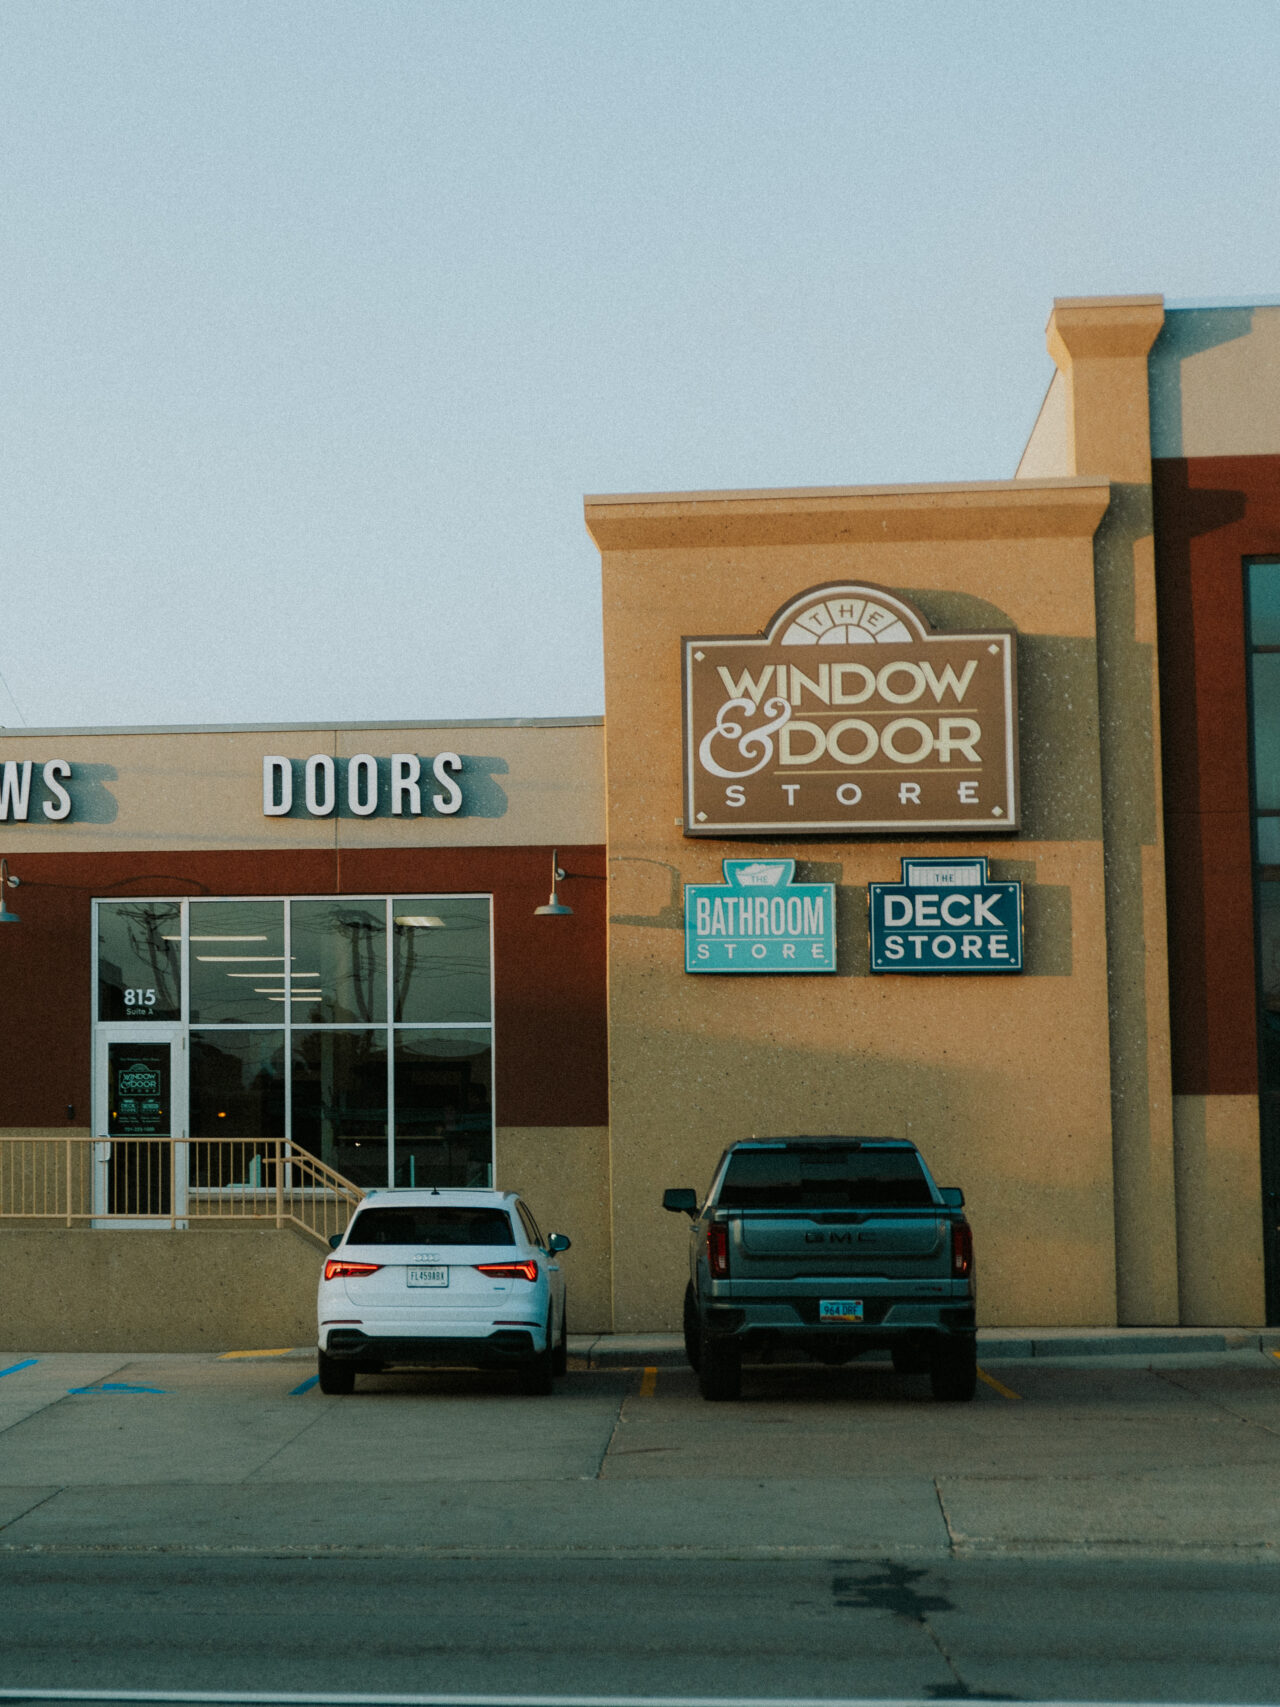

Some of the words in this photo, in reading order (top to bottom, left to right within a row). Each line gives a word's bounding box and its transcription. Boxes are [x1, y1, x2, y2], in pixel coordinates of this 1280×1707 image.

[809, 603, 884, 628] THE
[716, 660, 979, 707] WINDOW
[699, 697, 792, 778] &
[779, 717, 982, 765] DOOR
[263, 752, 463, 817] DOORS
[725, 781, 980, 808] STORE
[751, 875, 768, 884] THE
[935, 873, 955, 883] THE
[696, 896, 825, 936] BATHROOM
[884, 893, 1004, 927] DECK
[697, 943, 825, 960] STORE
[884, 935, 1010, 960] STORE
[124, 989, 156, 1006] 815
[126, 1008, 146, 1016] Suite
[147, 1008, 154, 1016] A
[130, 1080, 157, 1088] DOOR
[805, 1231, 876, 1244] GMC
[824, 1306, 840, 1315] 964
